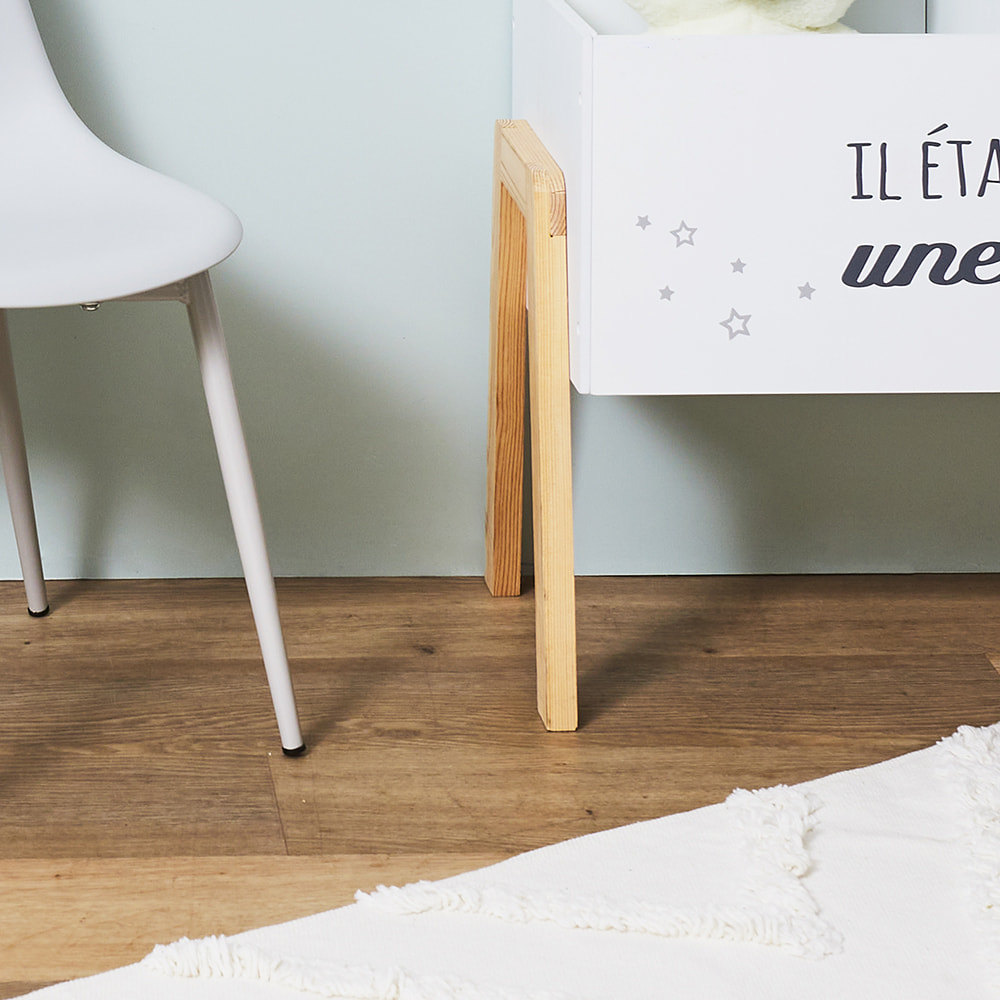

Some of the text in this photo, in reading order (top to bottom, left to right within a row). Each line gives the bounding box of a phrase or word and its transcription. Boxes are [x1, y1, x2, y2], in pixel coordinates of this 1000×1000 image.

[846, 122, 1000, 201] IL ÉTA
[841, 241, 1000, 288] une
